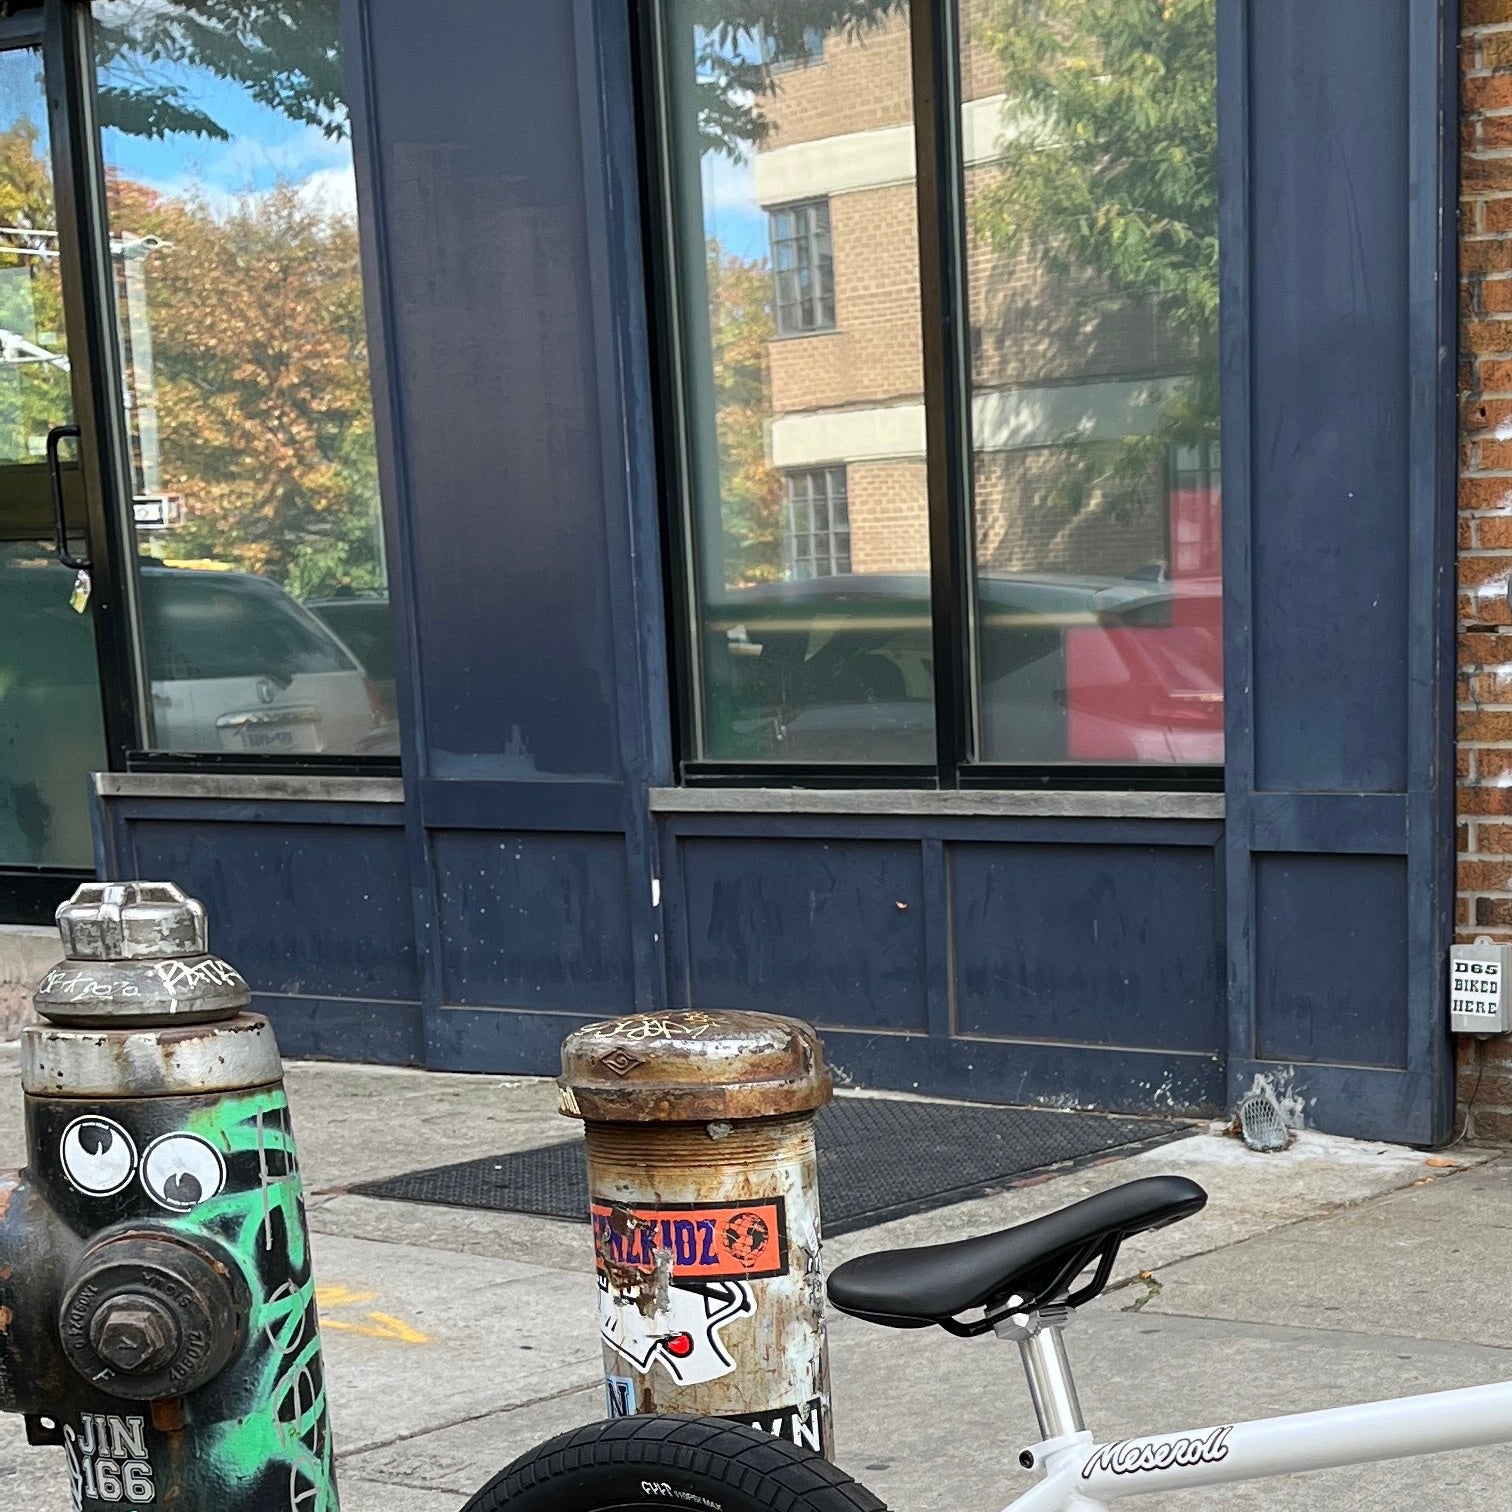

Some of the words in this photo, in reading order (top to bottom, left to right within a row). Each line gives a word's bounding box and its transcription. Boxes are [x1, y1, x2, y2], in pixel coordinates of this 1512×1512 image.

[1454, 979, 1498, 994] BIKED
[1453, 999, 1497, 1015] HERE
[77, 1411, 149, 1459] JIN
[1081, 1425, 1235, 1480] Meseroll
[82, 1459, 156, 1504] 166
[641, 1480, 673, 1498] CULT
